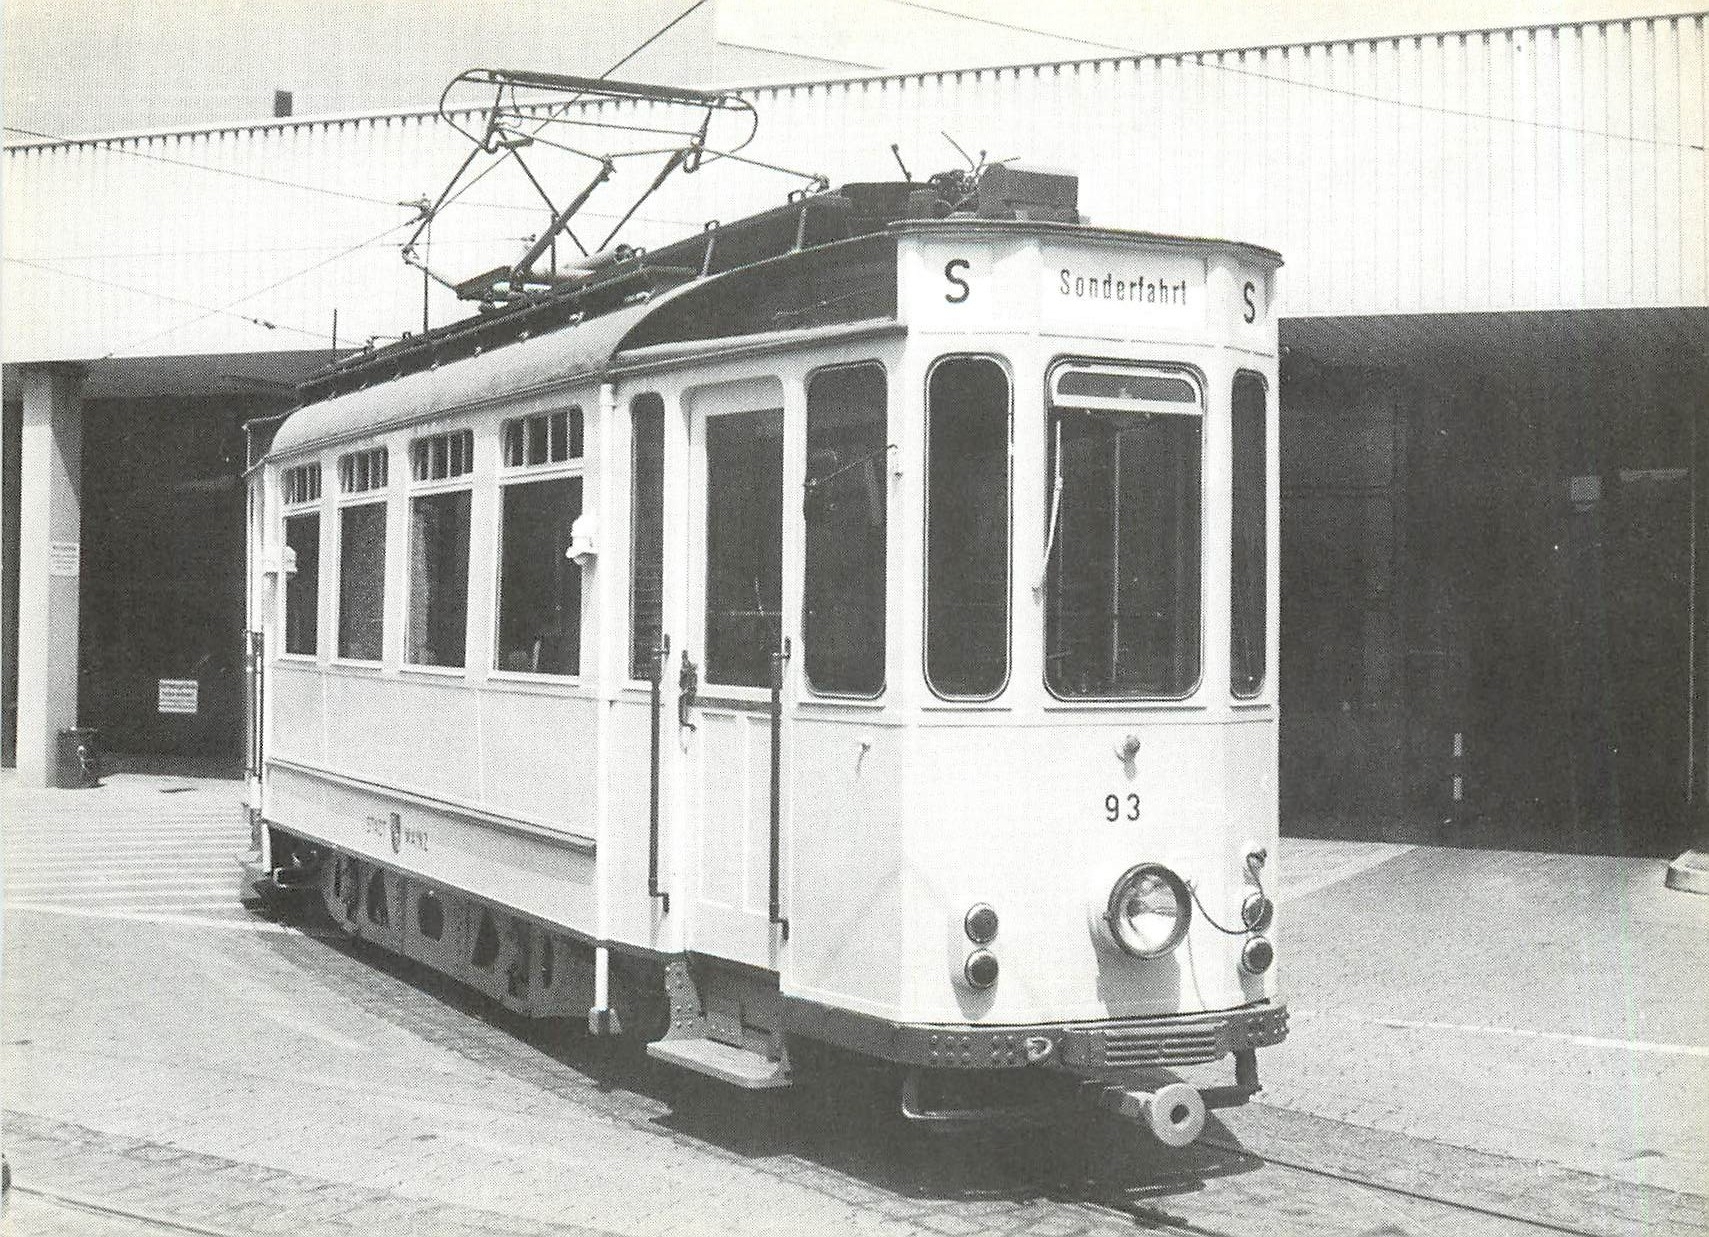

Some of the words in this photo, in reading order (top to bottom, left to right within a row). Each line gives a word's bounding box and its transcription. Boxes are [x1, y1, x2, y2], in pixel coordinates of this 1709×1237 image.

[944, 258, 970, 304] S
[1060, 268, 1187, 306] Sonderfahrt
[1243, 281, 1256, 324] S
[1105, 793, 1141, 822] 93
